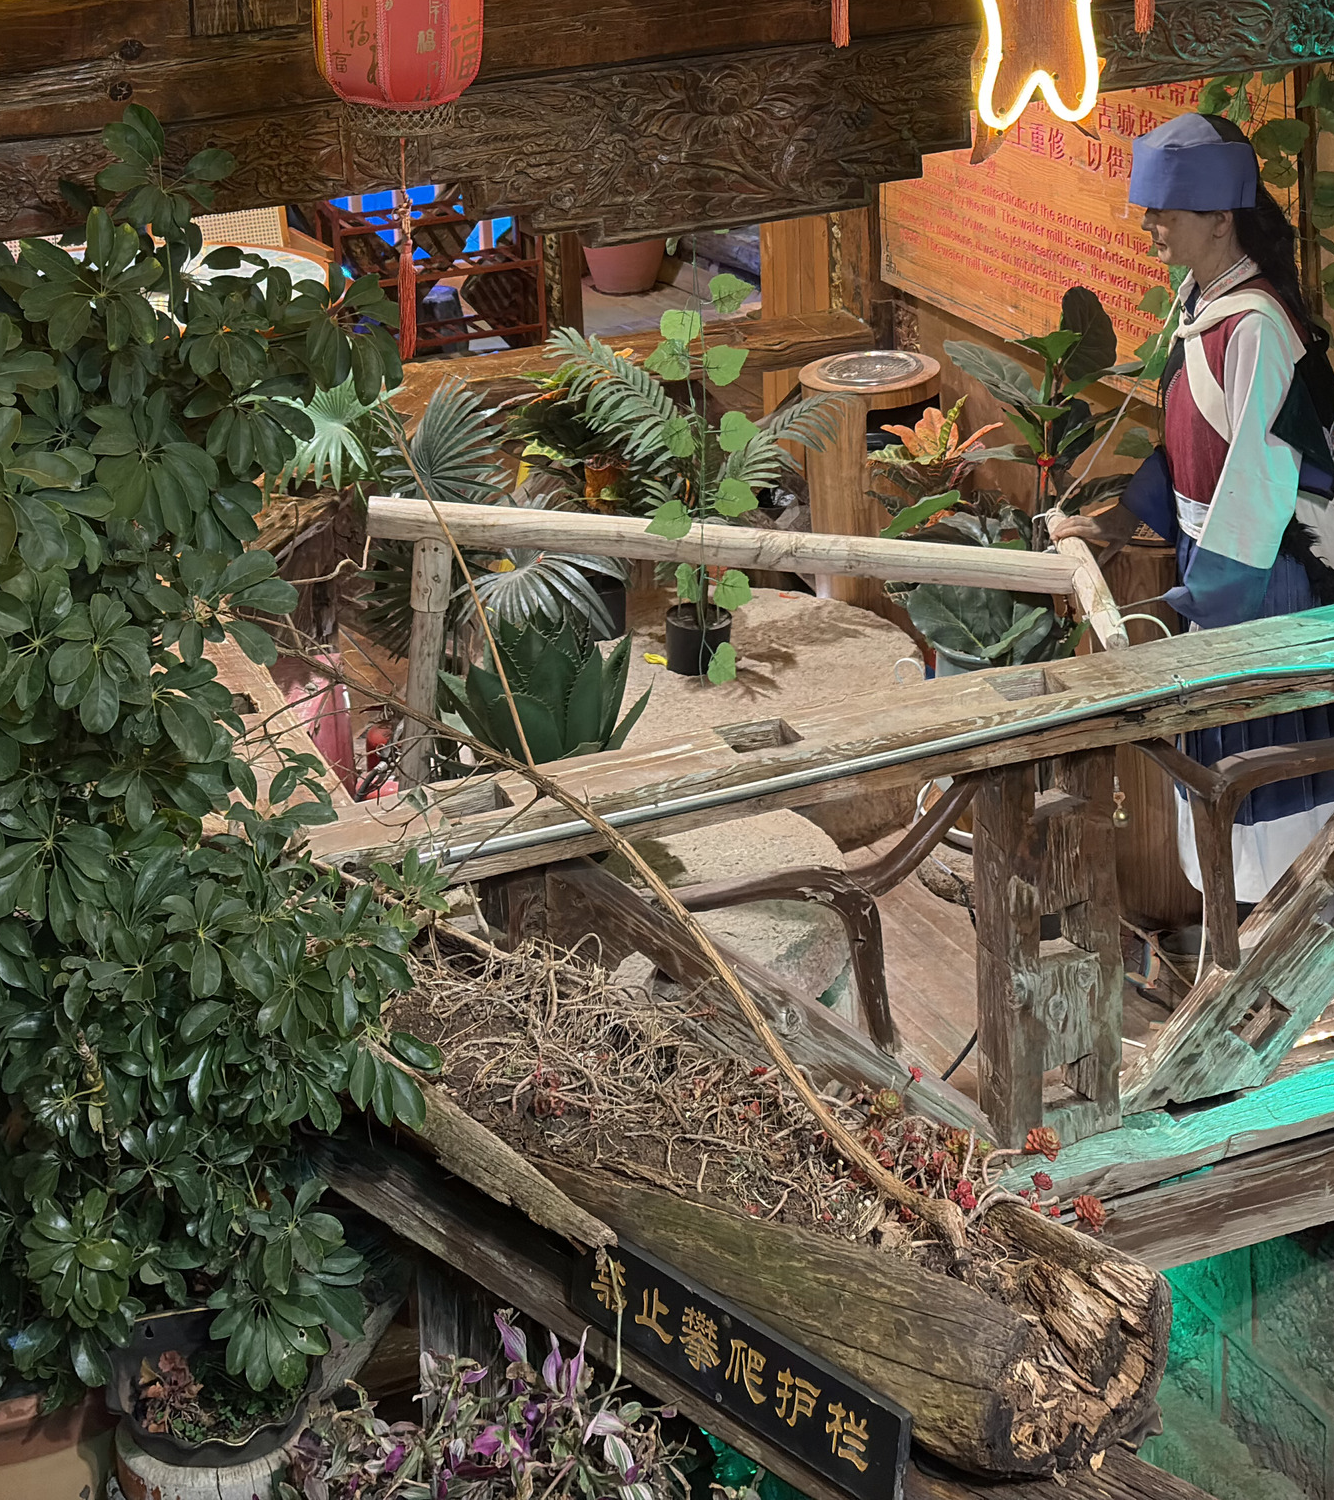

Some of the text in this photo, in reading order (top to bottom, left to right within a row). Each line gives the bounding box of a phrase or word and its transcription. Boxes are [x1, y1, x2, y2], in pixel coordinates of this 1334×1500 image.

[982, 184, 1028, 211] attractions
[1040, 204, 1055, 221] the
[1057, 211, 1094, 235] ancient
[1095, 223, 1112, 245] city
[1115, 231, 1125, 247] of
[1000, 208, 1017, 227] The
[1020, 217, 1045, 237] water
[1046, 228, 1063, 244] mill
[1091, 263, 1109, 282] the
[1109, 272, 1139, 295] water
[1125, 318, 1140, 337] for
[590, 1258, 871, 1474] 禁止攀爬护栏
